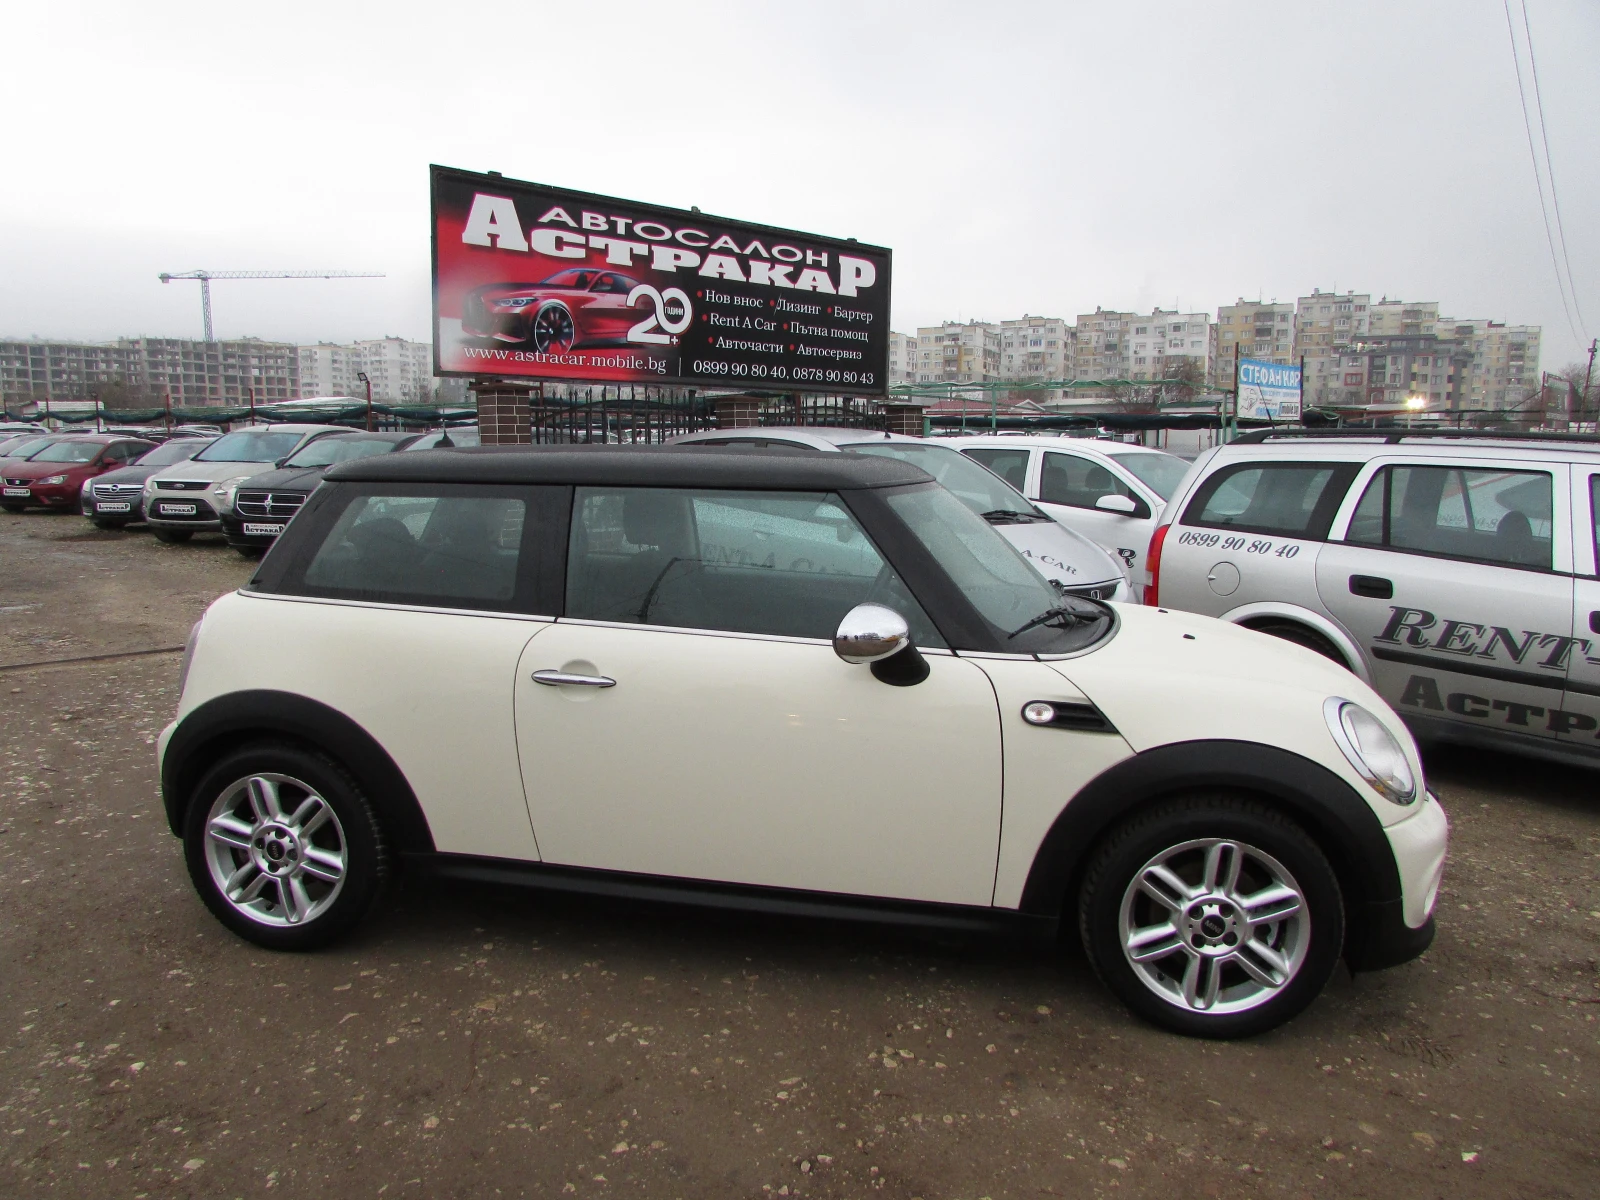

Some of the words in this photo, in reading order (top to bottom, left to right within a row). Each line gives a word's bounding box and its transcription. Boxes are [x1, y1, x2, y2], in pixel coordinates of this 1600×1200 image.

[461, 193, 877, 298] АСТРАКАР
[537, 206, 829, 268] АВТОСАЛОН
[705, 289, 731, 304] Нов
[733, 296, 764, 308] внос
[776, 298, 821, 315] Лизинг
[710, 313, 740, 327] Rent
[742, 316, 752, 329] A
[754, 317, 777, 332] Car
[834, 306, 873, 324] Бартер
[790, 321, 828, 337] Пътна
[830, 328, 869, 343] помощ
[715, 336, 784, 353] Авточасти
[796, 343, 862, 361] Автосервиз
[463, 346, 667, 374] www.astracar.mobile.bg
[693, 360, 728, 375] 0899
[731, 362, 748, 376] 90
[751, 364, 768, 377] 80
[792, 367, 823, 381] 0878
[825, 370, 841, 382] 90
[842, 371, 858, 383] 80
[859, 372, 874, 385] 43
[1240, 364, 1282, 387] СТЕФАН
[1282, 370, 1301, 387] КАР
[1178, 531, 1220, 548] 0899
[1221, 536, 1245, 551] 90
[1246, 540, 1272, 554] 80
[1275, 544, 1300, 559] 40
[1400, 674, 1600, 740] АСТР
[1204, 919, 1222, 934] MINI
